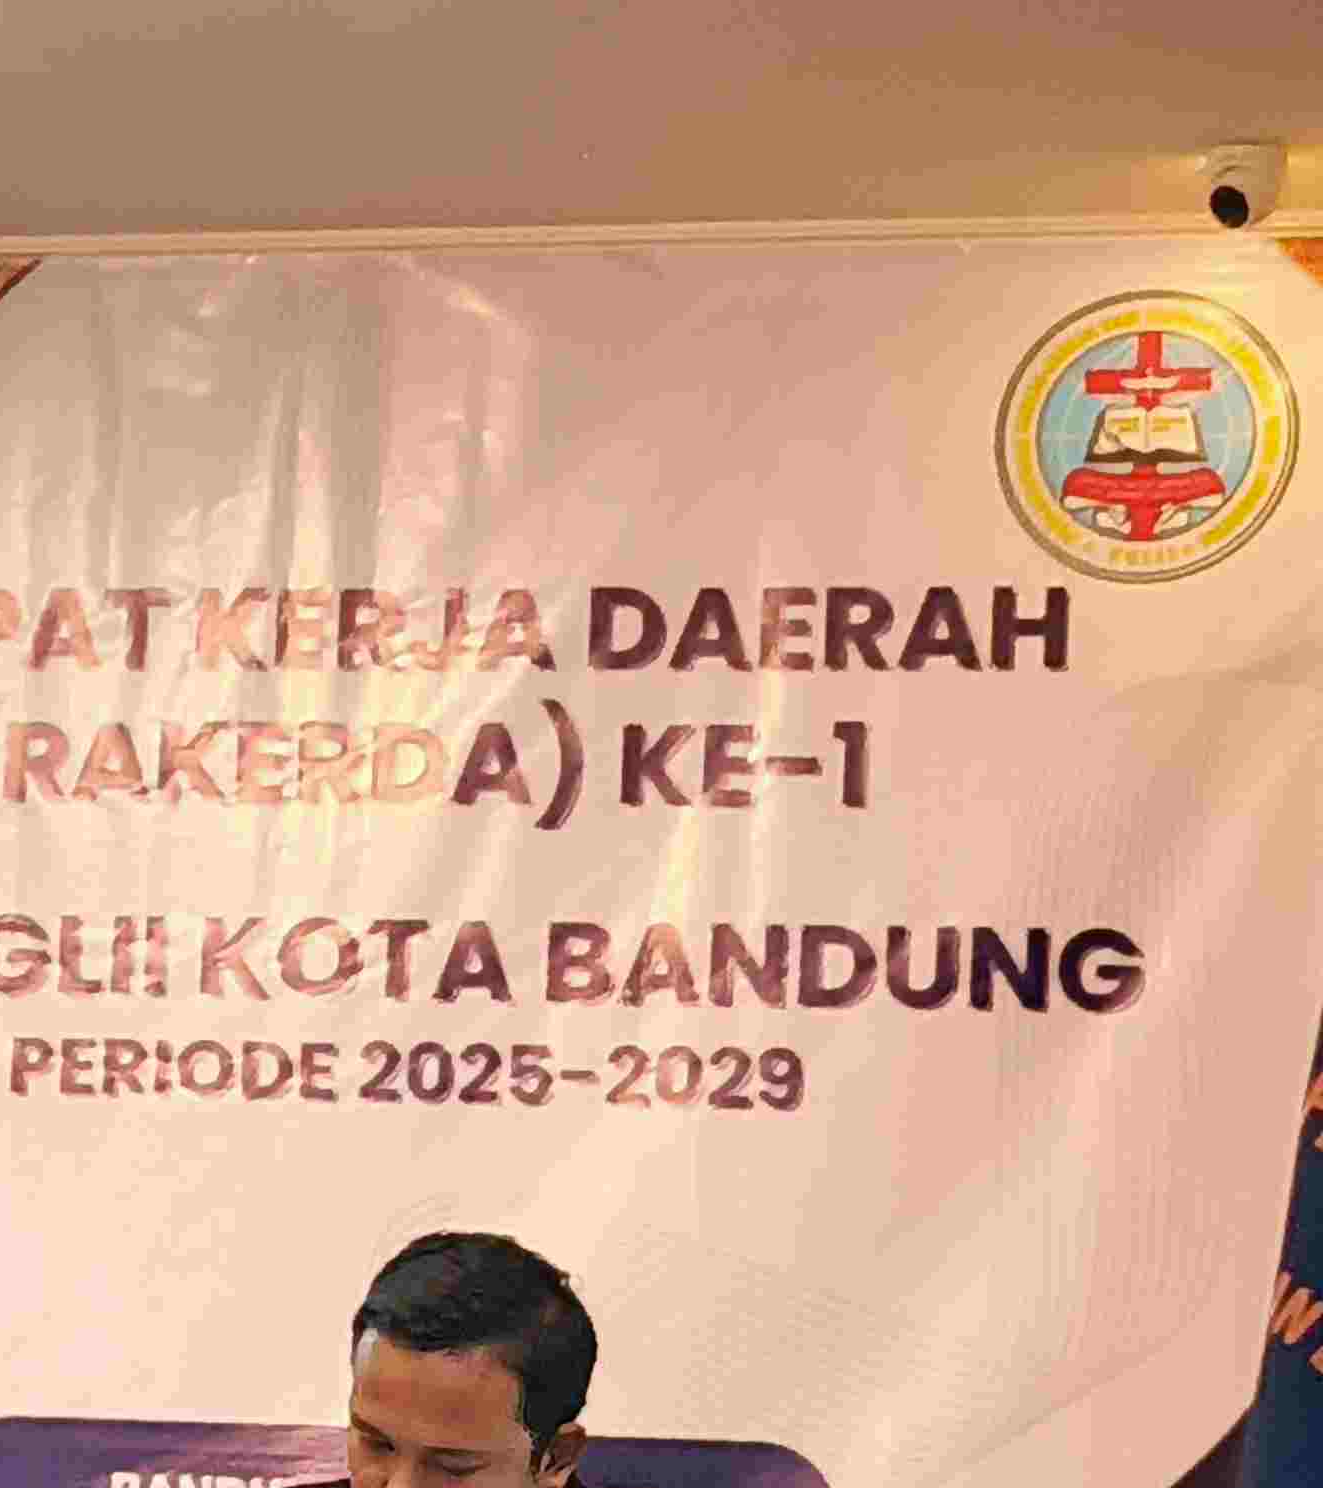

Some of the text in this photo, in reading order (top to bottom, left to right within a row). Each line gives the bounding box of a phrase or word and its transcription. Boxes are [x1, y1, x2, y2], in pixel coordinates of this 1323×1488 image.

[194, 586, 557, 673] KERJA
[587, 585, 1071, 673] DAERAH
[619, 720, 870, 810] KE-1
[198, 915, 514, 1003] KOTA
[545, 921, 1147, 1016] BANDUNG
[10, 1036, 341, 1104] PERIODE
